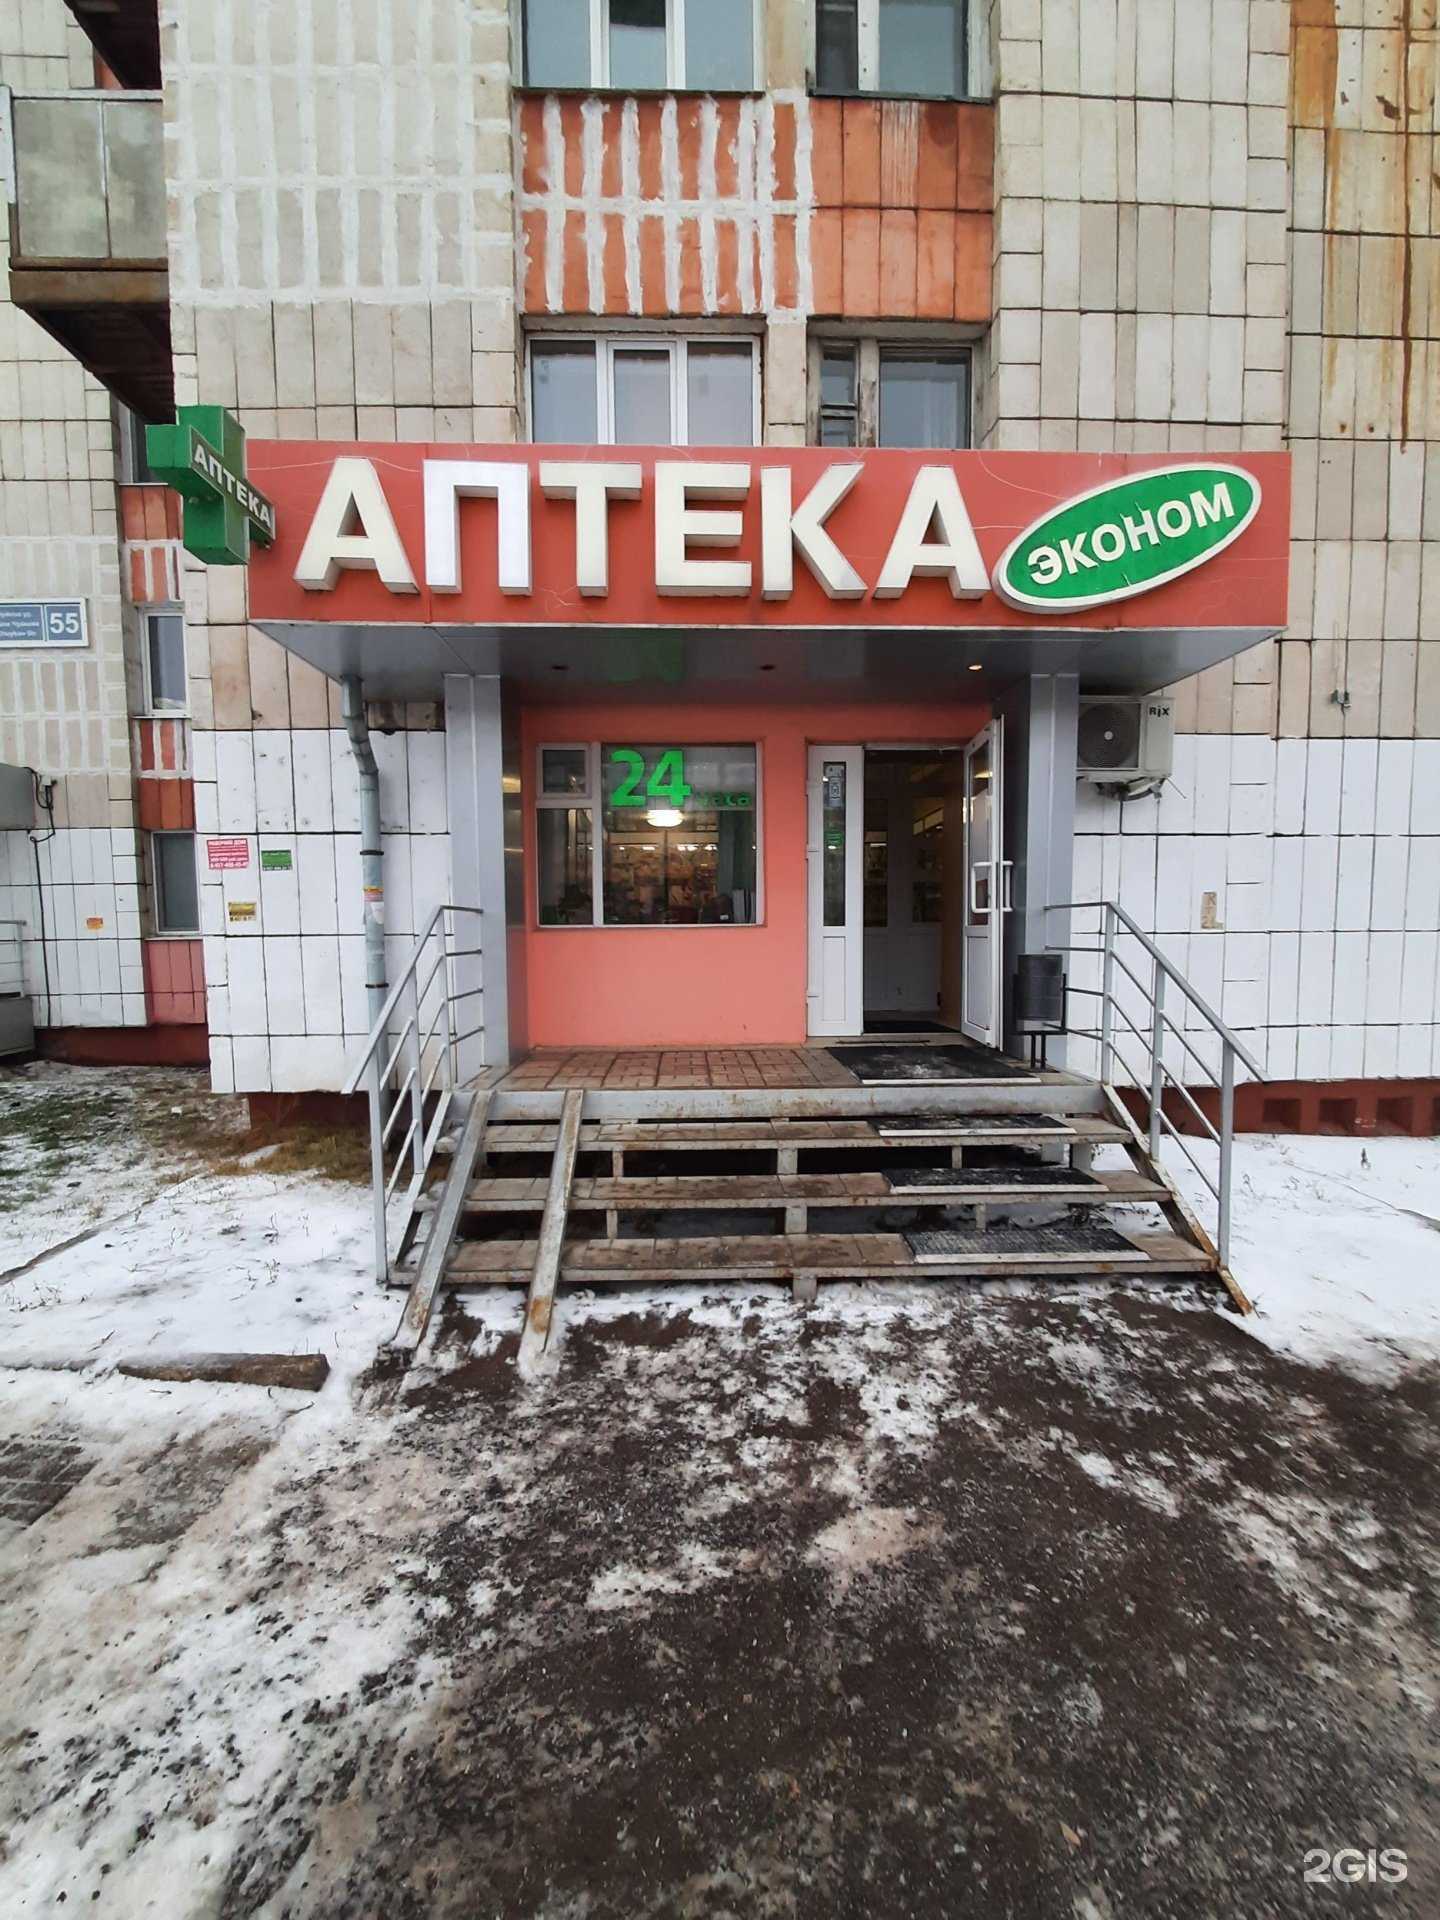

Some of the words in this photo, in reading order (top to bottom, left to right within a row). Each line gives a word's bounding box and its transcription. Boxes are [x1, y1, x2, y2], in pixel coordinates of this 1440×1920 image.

[195, 444, 272, 528] АПТЕКА
[292, 456, 992, 597] АПТЕКА
[1027, 481, 1236, 585] ЭКОНОМ
[49, 612, 80, 634] 55
[611, 748, 691, 808] 24
